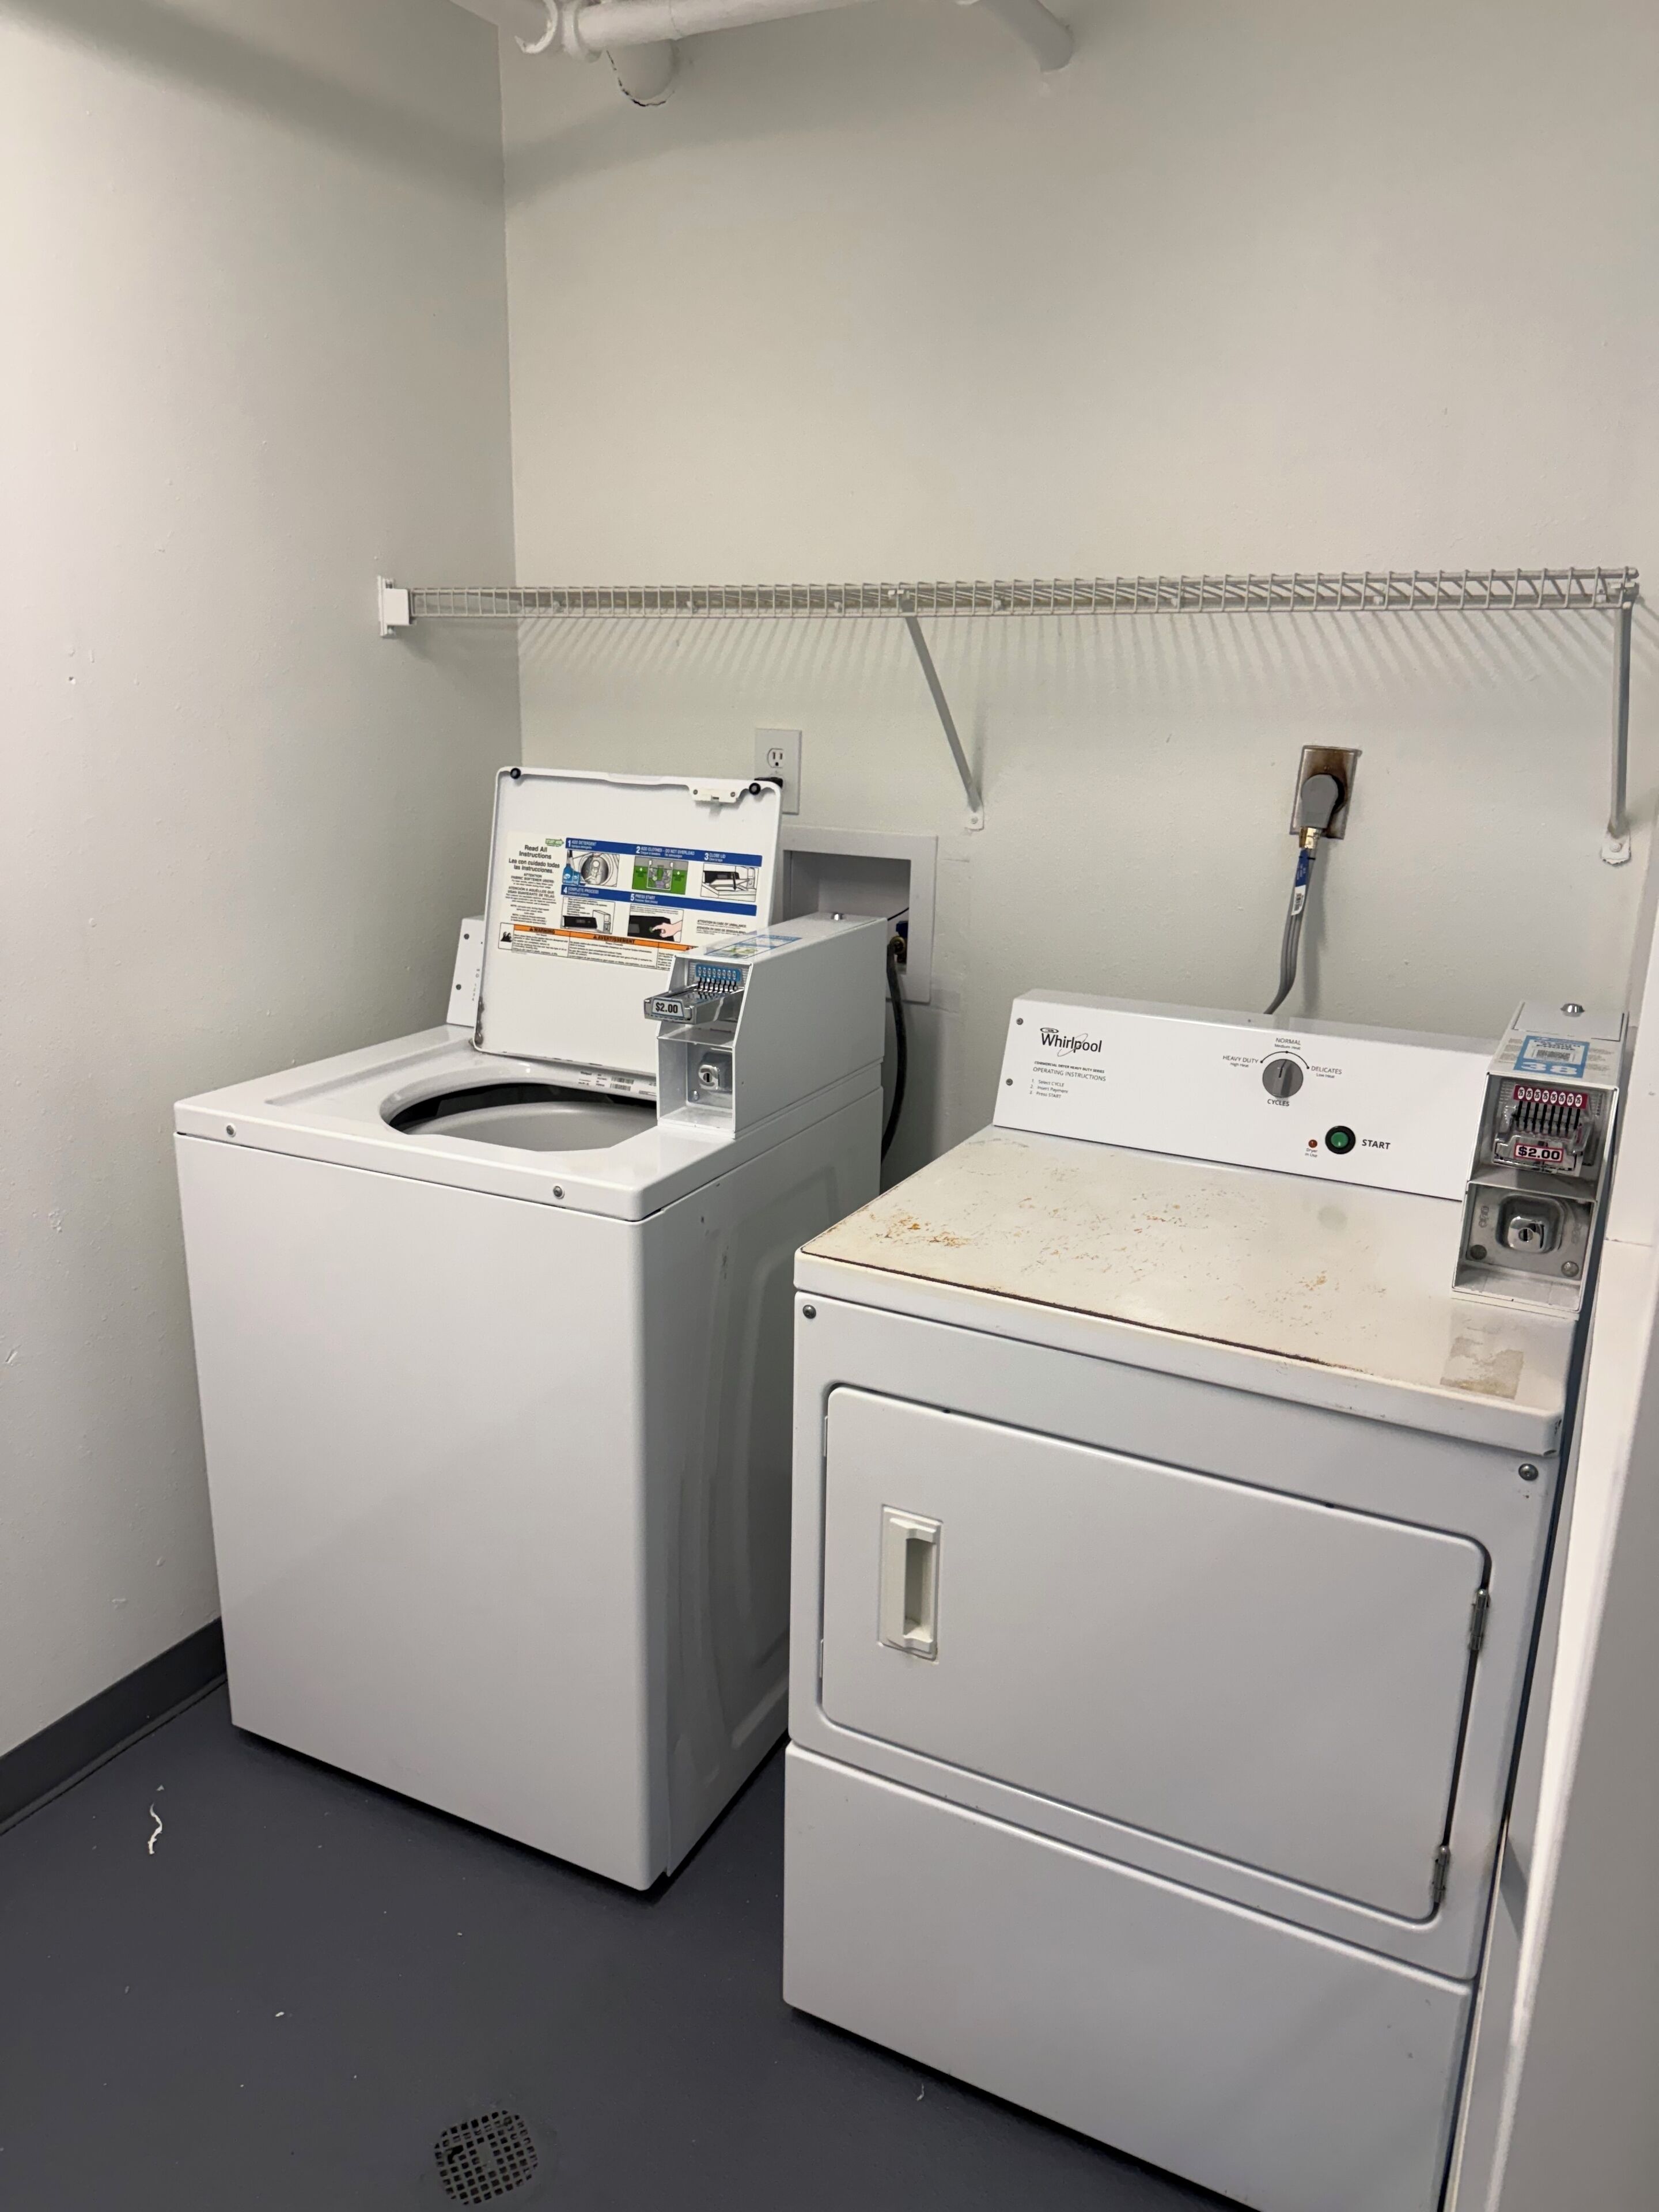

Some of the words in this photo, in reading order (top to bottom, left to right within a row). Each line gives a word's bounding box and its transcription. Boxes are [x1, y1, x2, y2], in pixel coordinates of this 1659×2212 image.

[519, 851, 551, 859] Instructions
[630, 893, 635, 902] 5
[656, 1002, 678, 1014] $2.00
[1041, 1033, 1102, 1053] Whirlpool
[1275, 1037, 1301, 1046] NORMAL
[1033, 1067, 1064, 1075] OPERATING
[1065, 1071, 1106, 1081] INSTRUCTIONS
[1311, 1066, 1342, 1075] DELICATES
[1521, 1062, 1577, 1075] 38
[1267, 1099, 1290, 1107] CYCLES
[1362, 1139, 1391, 1150] START
[1518, 1146, 1560, 1160] $2.00
